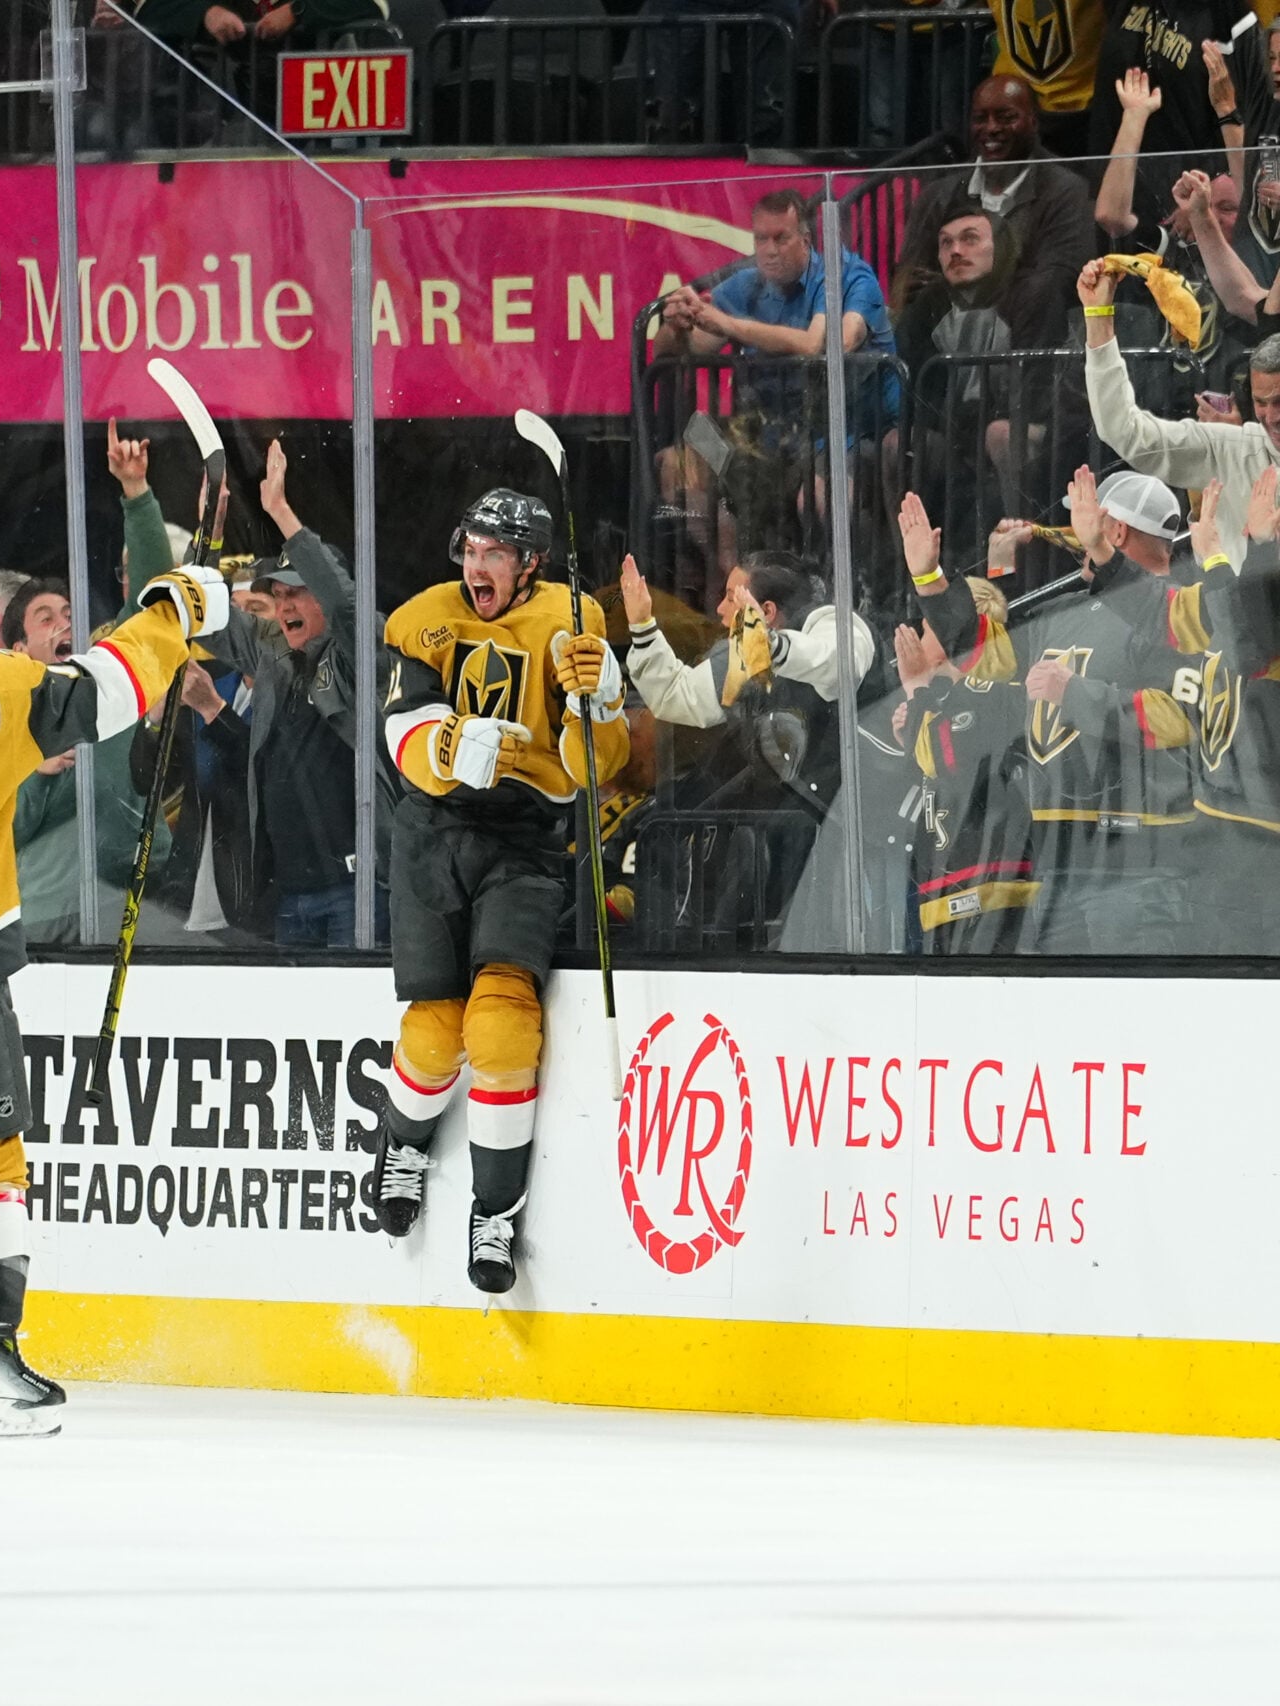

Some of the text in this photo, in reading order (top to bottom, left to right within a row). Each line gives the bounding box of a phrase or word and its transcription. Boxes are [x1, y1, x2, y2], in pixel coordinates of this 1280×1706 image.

[303, 58, 392, 129] EXIT
[18, 253, 314, 353] Mobile
[421, 625, 449, 649] Circa
[433, 632, 455, 650] SPORTS
[1172, 667, 1204, 706] 6
[439, 715, 460, 768] BAU
[20, 1034, 395, 1155] TAVERNS
[776, 1055, 1148, 1156] WESTGATE
[26, 1161, 384, 1238] HEADQUARTERS
[823, 1190, 1085, 1245] LAS VEGAS
